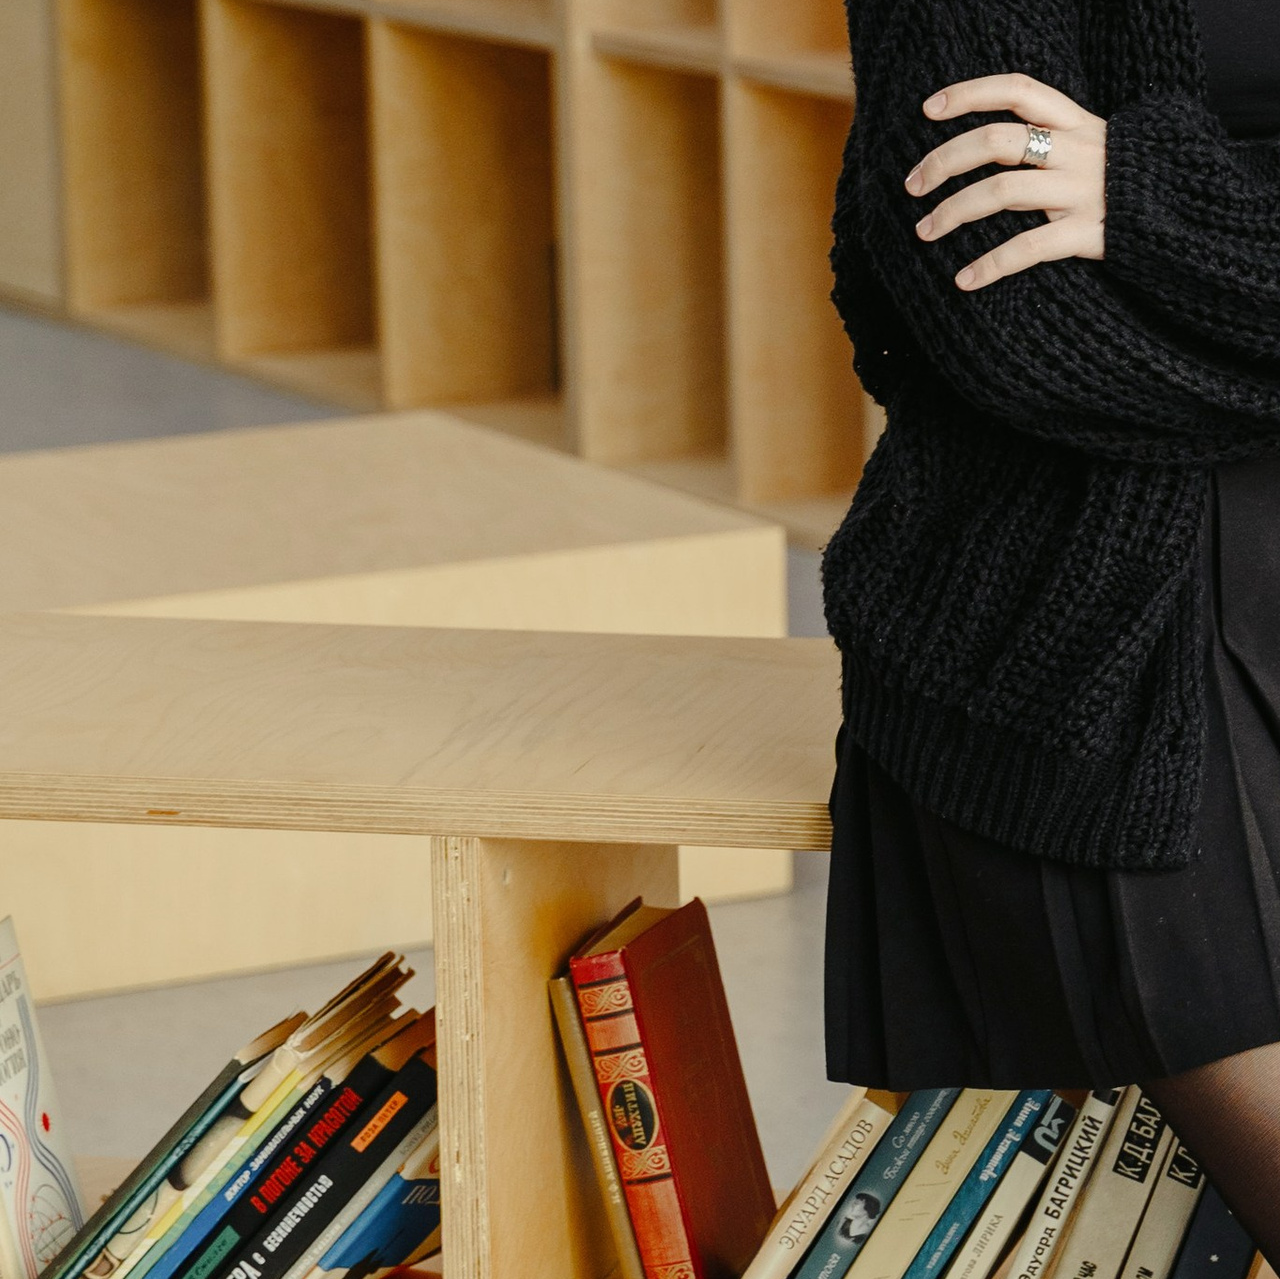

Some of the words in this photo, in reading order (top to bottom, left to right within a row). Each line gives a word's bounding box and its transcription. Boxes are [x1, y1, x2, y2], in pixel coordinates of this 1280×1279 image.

[224, 1170, 251, 1202] ДОКТОР
[249, 1107, 307, 1171] ЗАНИМАТЕЛЬНЫХ
[303, 1084, 325, 1109] НАУК
[308, 1086, 363, 1148] КРАСОТОЙ
[622, 1082, 647, 1145] АПУХТИН
[258, 1155, 303, 1203] ПОГОНЕ
[294, 1141, 317, 1163] ЗА
[1044, 1114, 1103, 1220] БАГРИЦКИЙ
[250, 1196, 268, 1214] В
[263, 1174, 334, 1253] БЕСКОНЕЧНОСТЬЮ
[779, 1185, 832, 1250] ЭДУАРД
[824, 1118, 874, 1189] АСАДОВ
[972, 1213, 1004, 1259] ЛИРИКА
[1081, 1260, 1097, 1279] ЧАС
